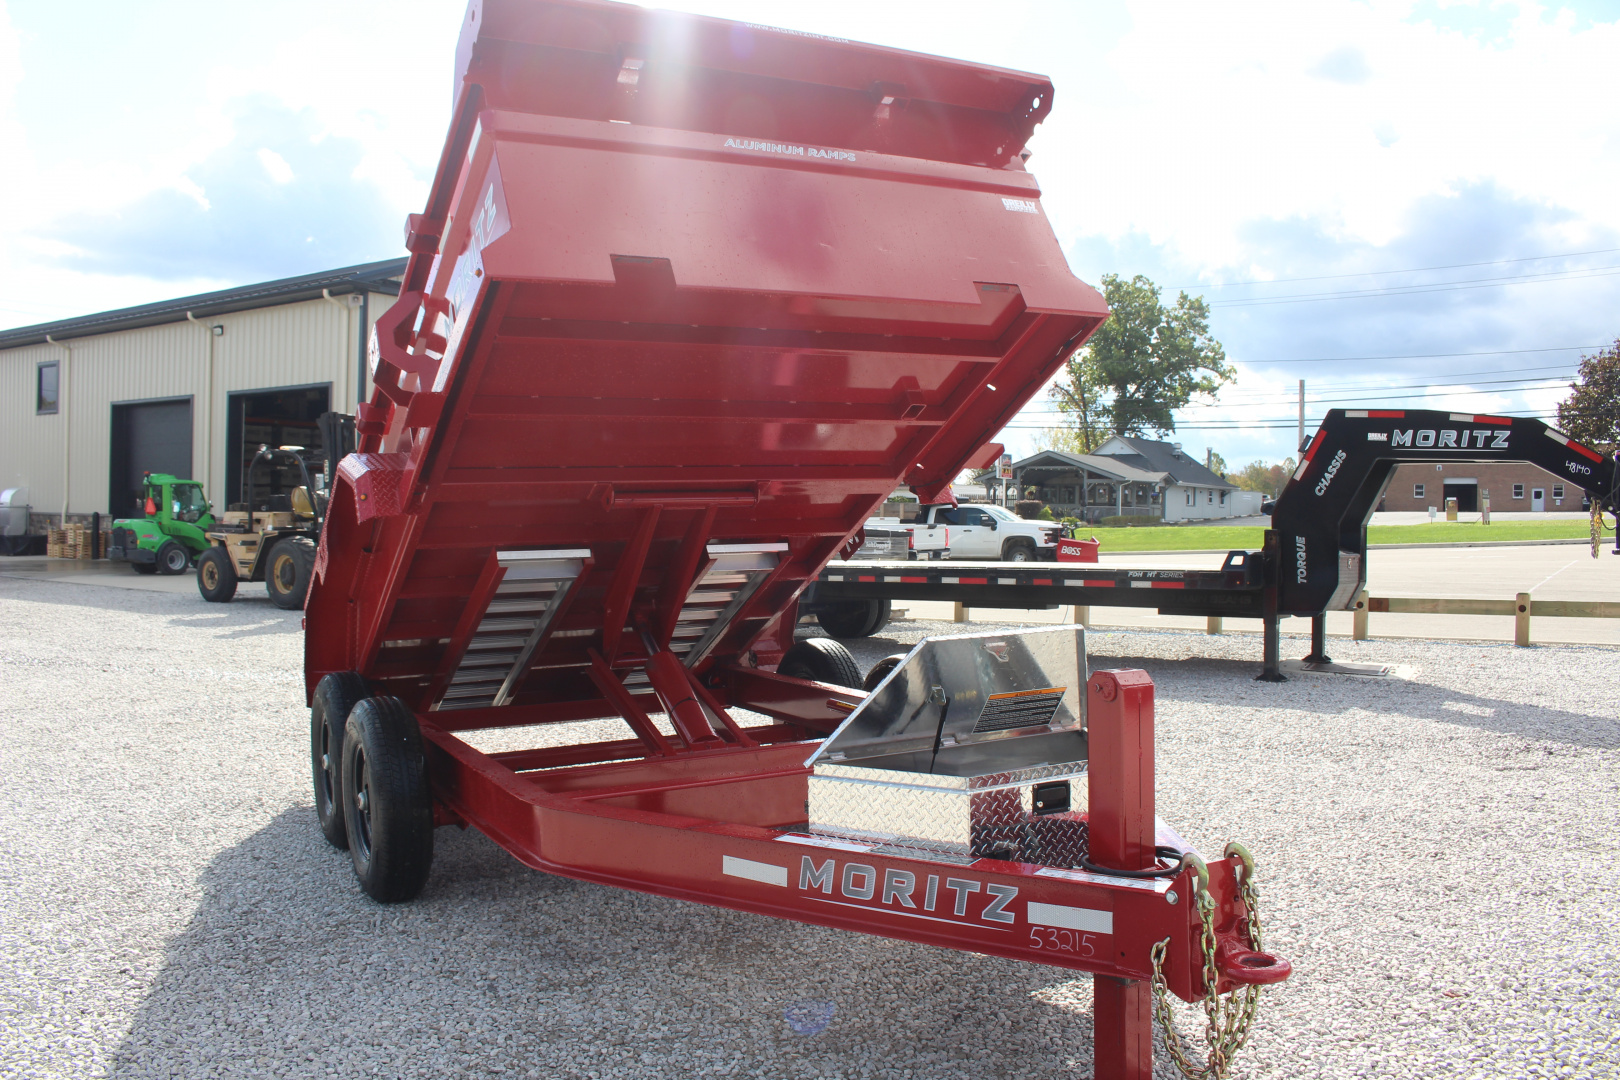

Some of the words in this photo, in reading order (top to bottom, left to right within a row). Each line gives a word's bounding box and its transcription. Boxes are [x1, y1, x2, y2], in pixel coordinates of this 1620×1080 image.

[724, 138, 804, 155] ALUMINUM
[808, 148, 856, 162] RAMPS
[1391, 429, 1511, 448] MORITZ
[1314, 449, 1347, 497] CHASSIS
[1061, 545, 1082, 556] BOSS
[1296, 535, 1307, 584] TORQUE
[799, 855, 1019, 925] MORITZ
[1029, 926, 1097, 957] 53215
